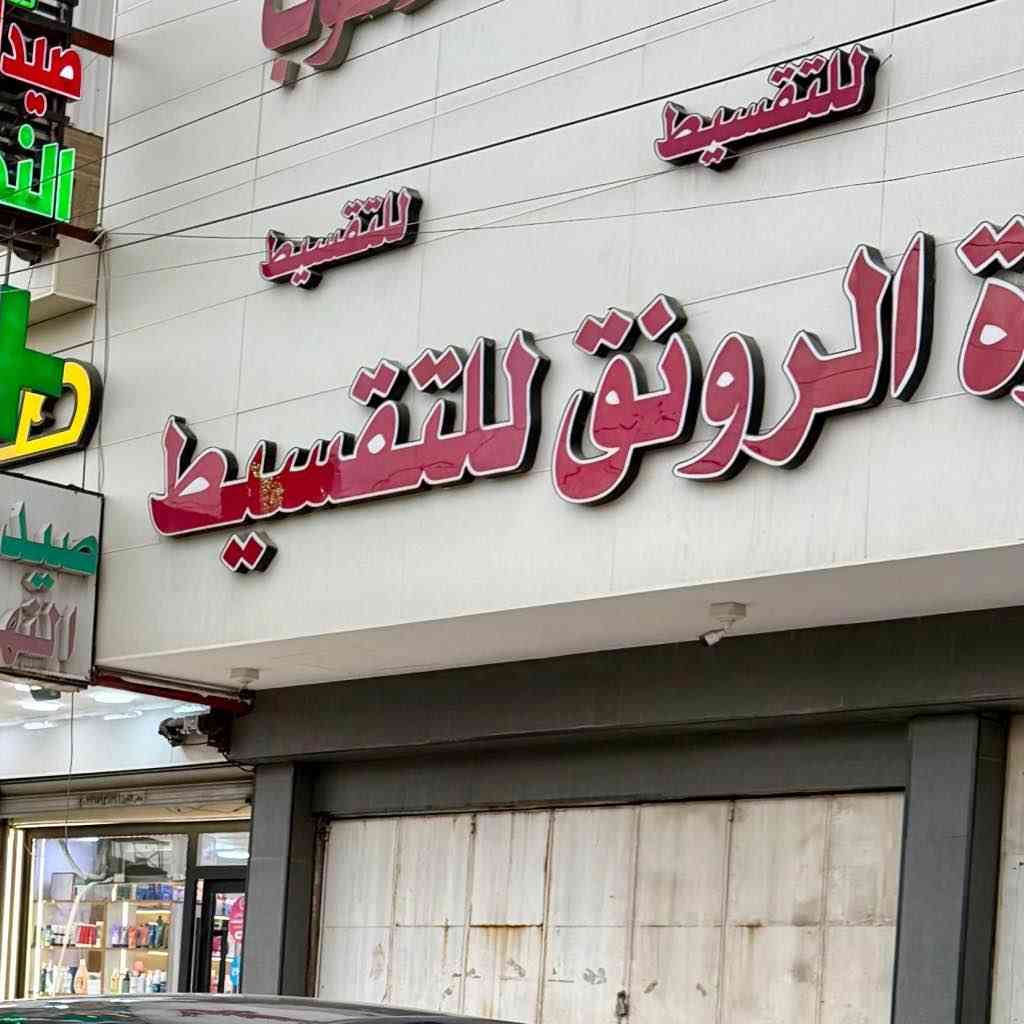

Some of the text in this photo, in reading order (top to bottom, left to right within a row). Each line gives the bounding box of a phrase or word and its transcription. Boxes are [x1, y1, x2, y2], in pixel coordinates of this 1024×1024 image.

[653, 43, 879, 173] للتقسيط
[259, 186, 422, 290] للتقسيط
[148, 328, 550, 574] للتقسيط
[550, 230, 935, 507] الرونق
